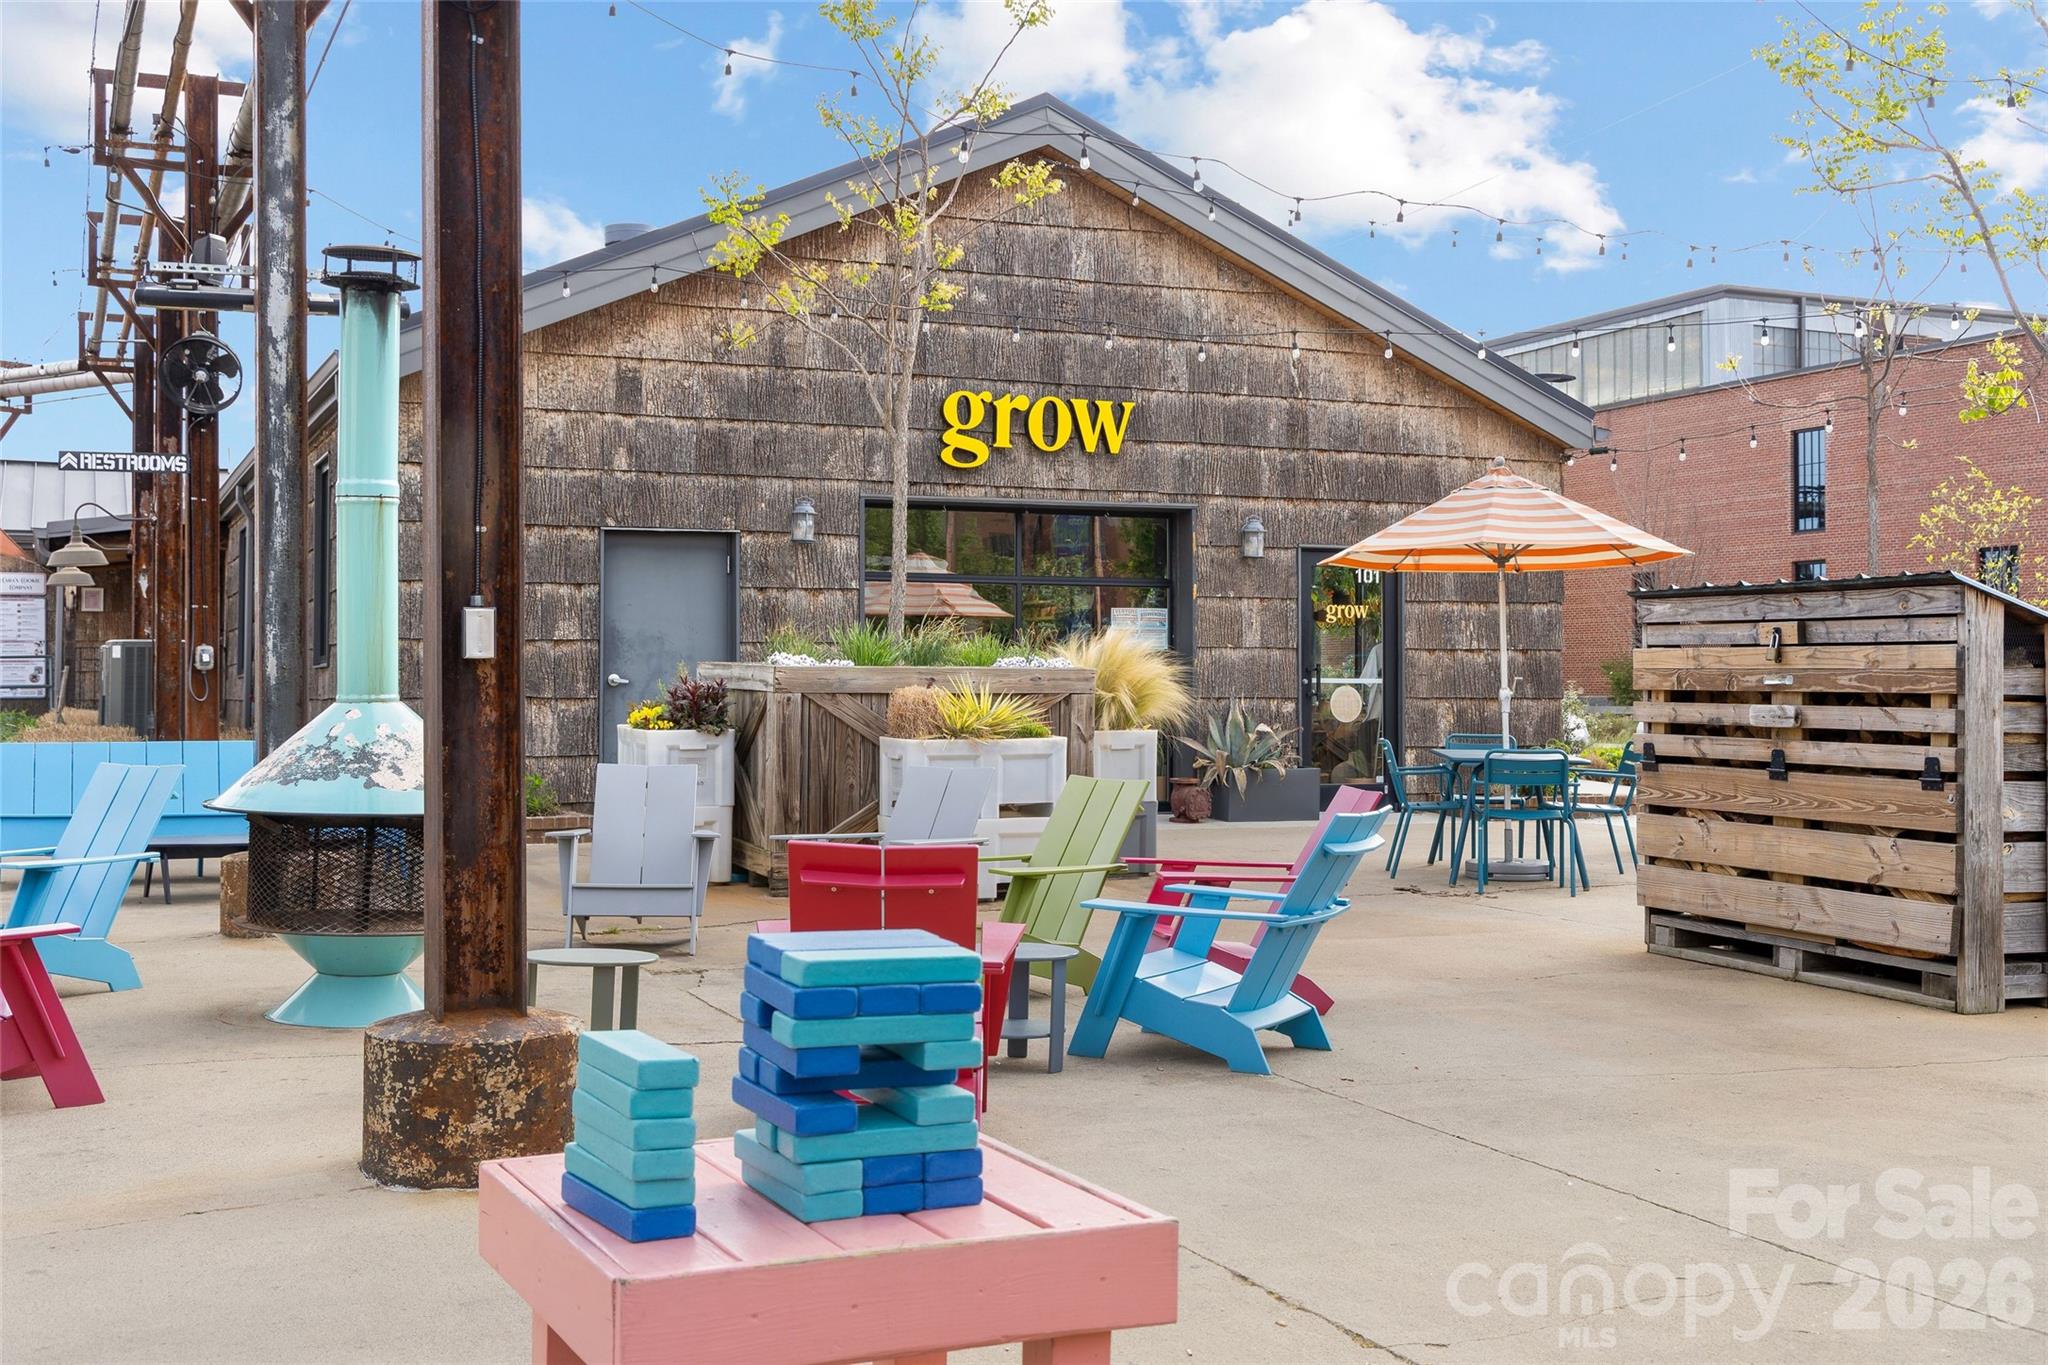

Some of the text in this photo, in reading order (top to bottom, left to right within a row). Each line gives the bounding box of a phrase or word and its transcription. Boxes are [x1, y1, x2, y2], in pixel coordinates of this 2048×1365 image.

[940, 390, 1136, 468] grow
[80, 452, 187, 472] RESTROOMS
[1355, 568, 1380, 584] 101
[1325, 604, 1370, 624] grow
